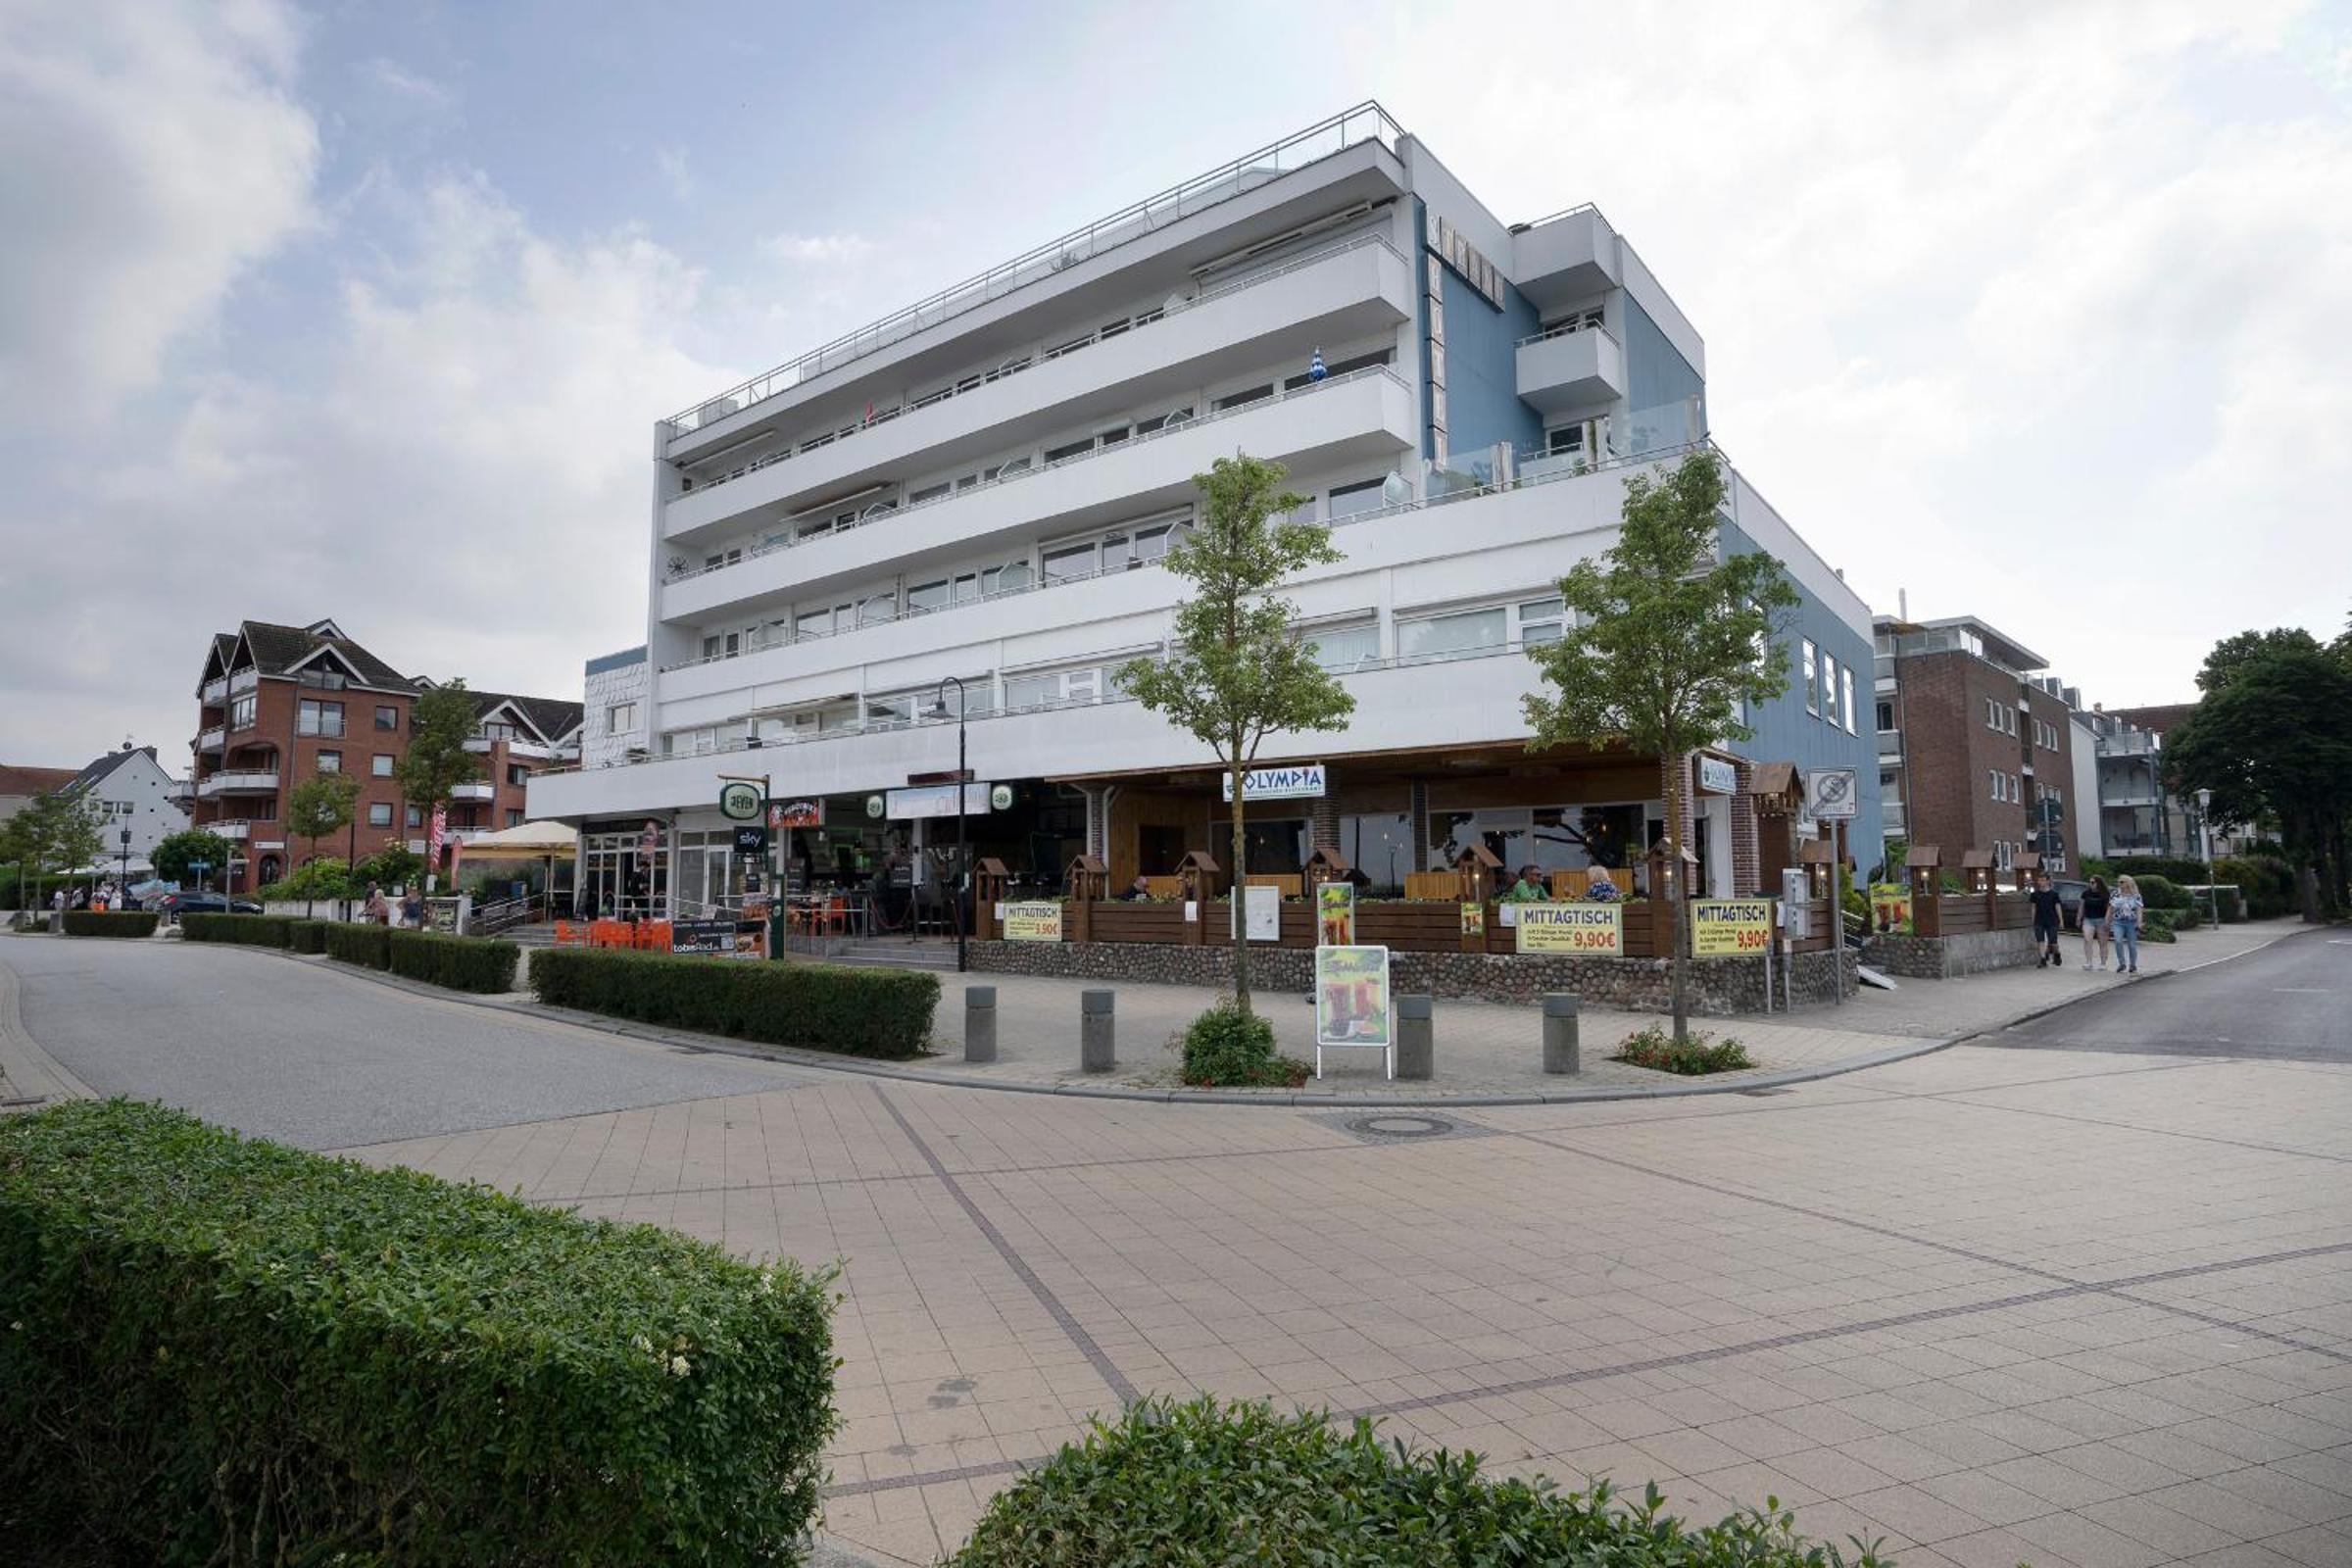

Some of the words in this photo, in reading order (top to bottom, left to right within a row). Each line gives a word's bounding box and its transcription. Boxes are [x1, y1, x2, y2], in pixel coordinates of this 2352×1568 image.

[1244, 769, 1321, 789] OLYMPIA
[739, 832, 761, 847] sky
[1008, 906, 1057, 918] MITTAGTISCH
[1524, 909, 1613, 924] MITTAGTISCH
[1697, 905, 1766, 922] MITTAGTISCH
[1574, 931, 1616, 950] 9,90€
[1737, 929, 1768, 951] 9,90€
